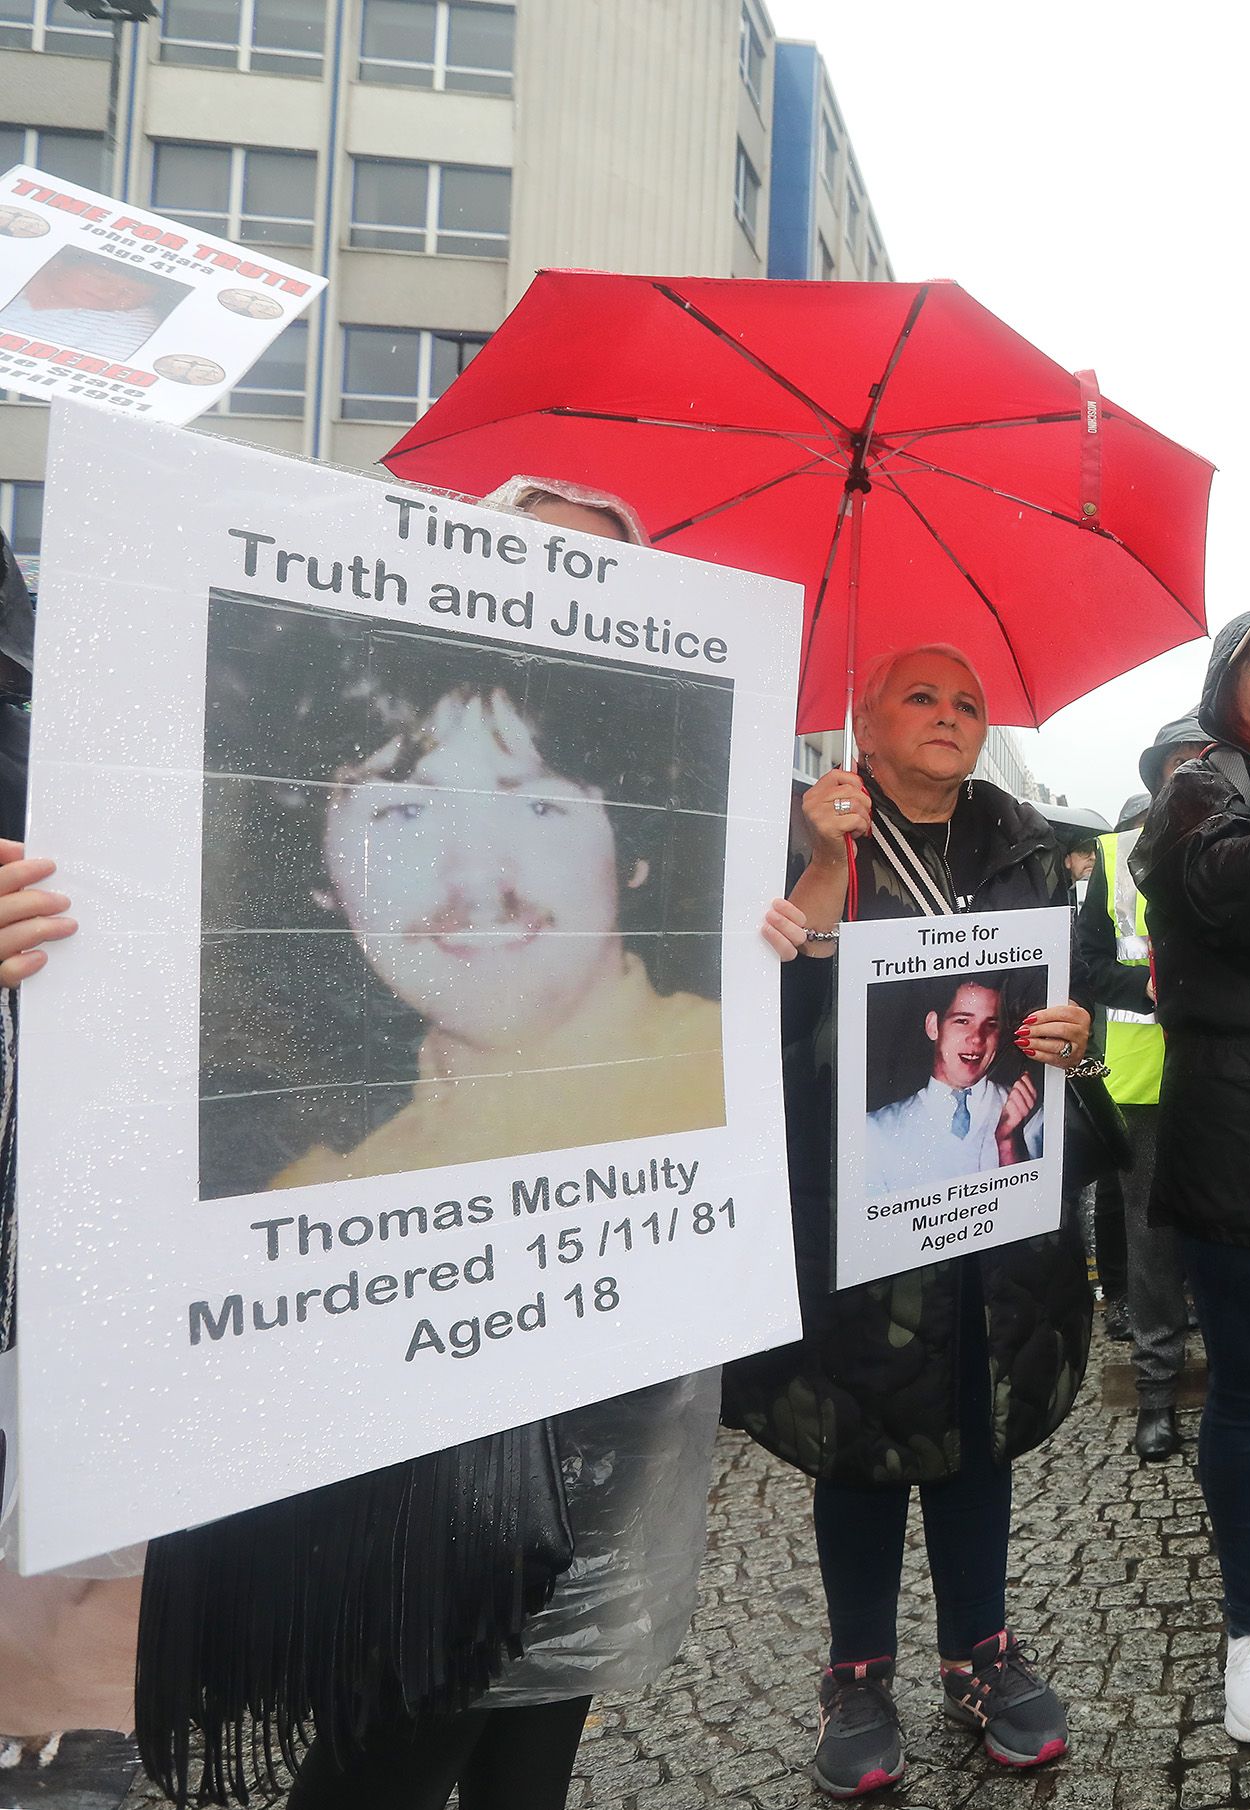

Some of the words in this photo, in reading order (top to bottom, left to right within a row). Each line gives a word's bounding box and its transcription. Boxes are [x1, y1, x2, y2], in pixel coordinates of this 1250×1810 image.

[11, 178, 113, 222] TIME
[110, 216, 190, 251] FOR
[196, 243, 312, 298] TRUTH
[79, 222, 137, 249] John
[140, 242, 217, 276] O'Hara
[99, 243, 146, 264] Age
[149, 260, 177, 274] 41
[0, 332, 160, 388] RDERED
[47, 366, 146, 398] State
[68, 384, 152, 412] 1991
[385, 494, 528, 565] Time
[544, 536, 618, 584] for
[228, 528, 407, 606] Truth
[429, 583, 534, 630] and
[551, 599, 729, 664] Justice
[871, 957, 927, 977] Truth
[932, 951, 970, 971] and
[974, 946, 1044, 968] Justice
[918, 928, 966, 947] Time
[971, 924, 1000, 943] for
[250, 1191, 494, 1262] Thomas
[511, 1156, 700, 1217] McNulty
[866, 1191, 942, 1222] Seamus
[948, 1168, 1040, 1202] Fitzsimons
[912, 1197, 999, 1232] Murdered
[920, 1225, 968, 1251] Aged
[972, 1220, 994, 1237] 20
[189, 1244, 496, 1347] Murdered
[404, 1292, 547, 1363] Aged
[562, 1276, 621, 1319] 18
